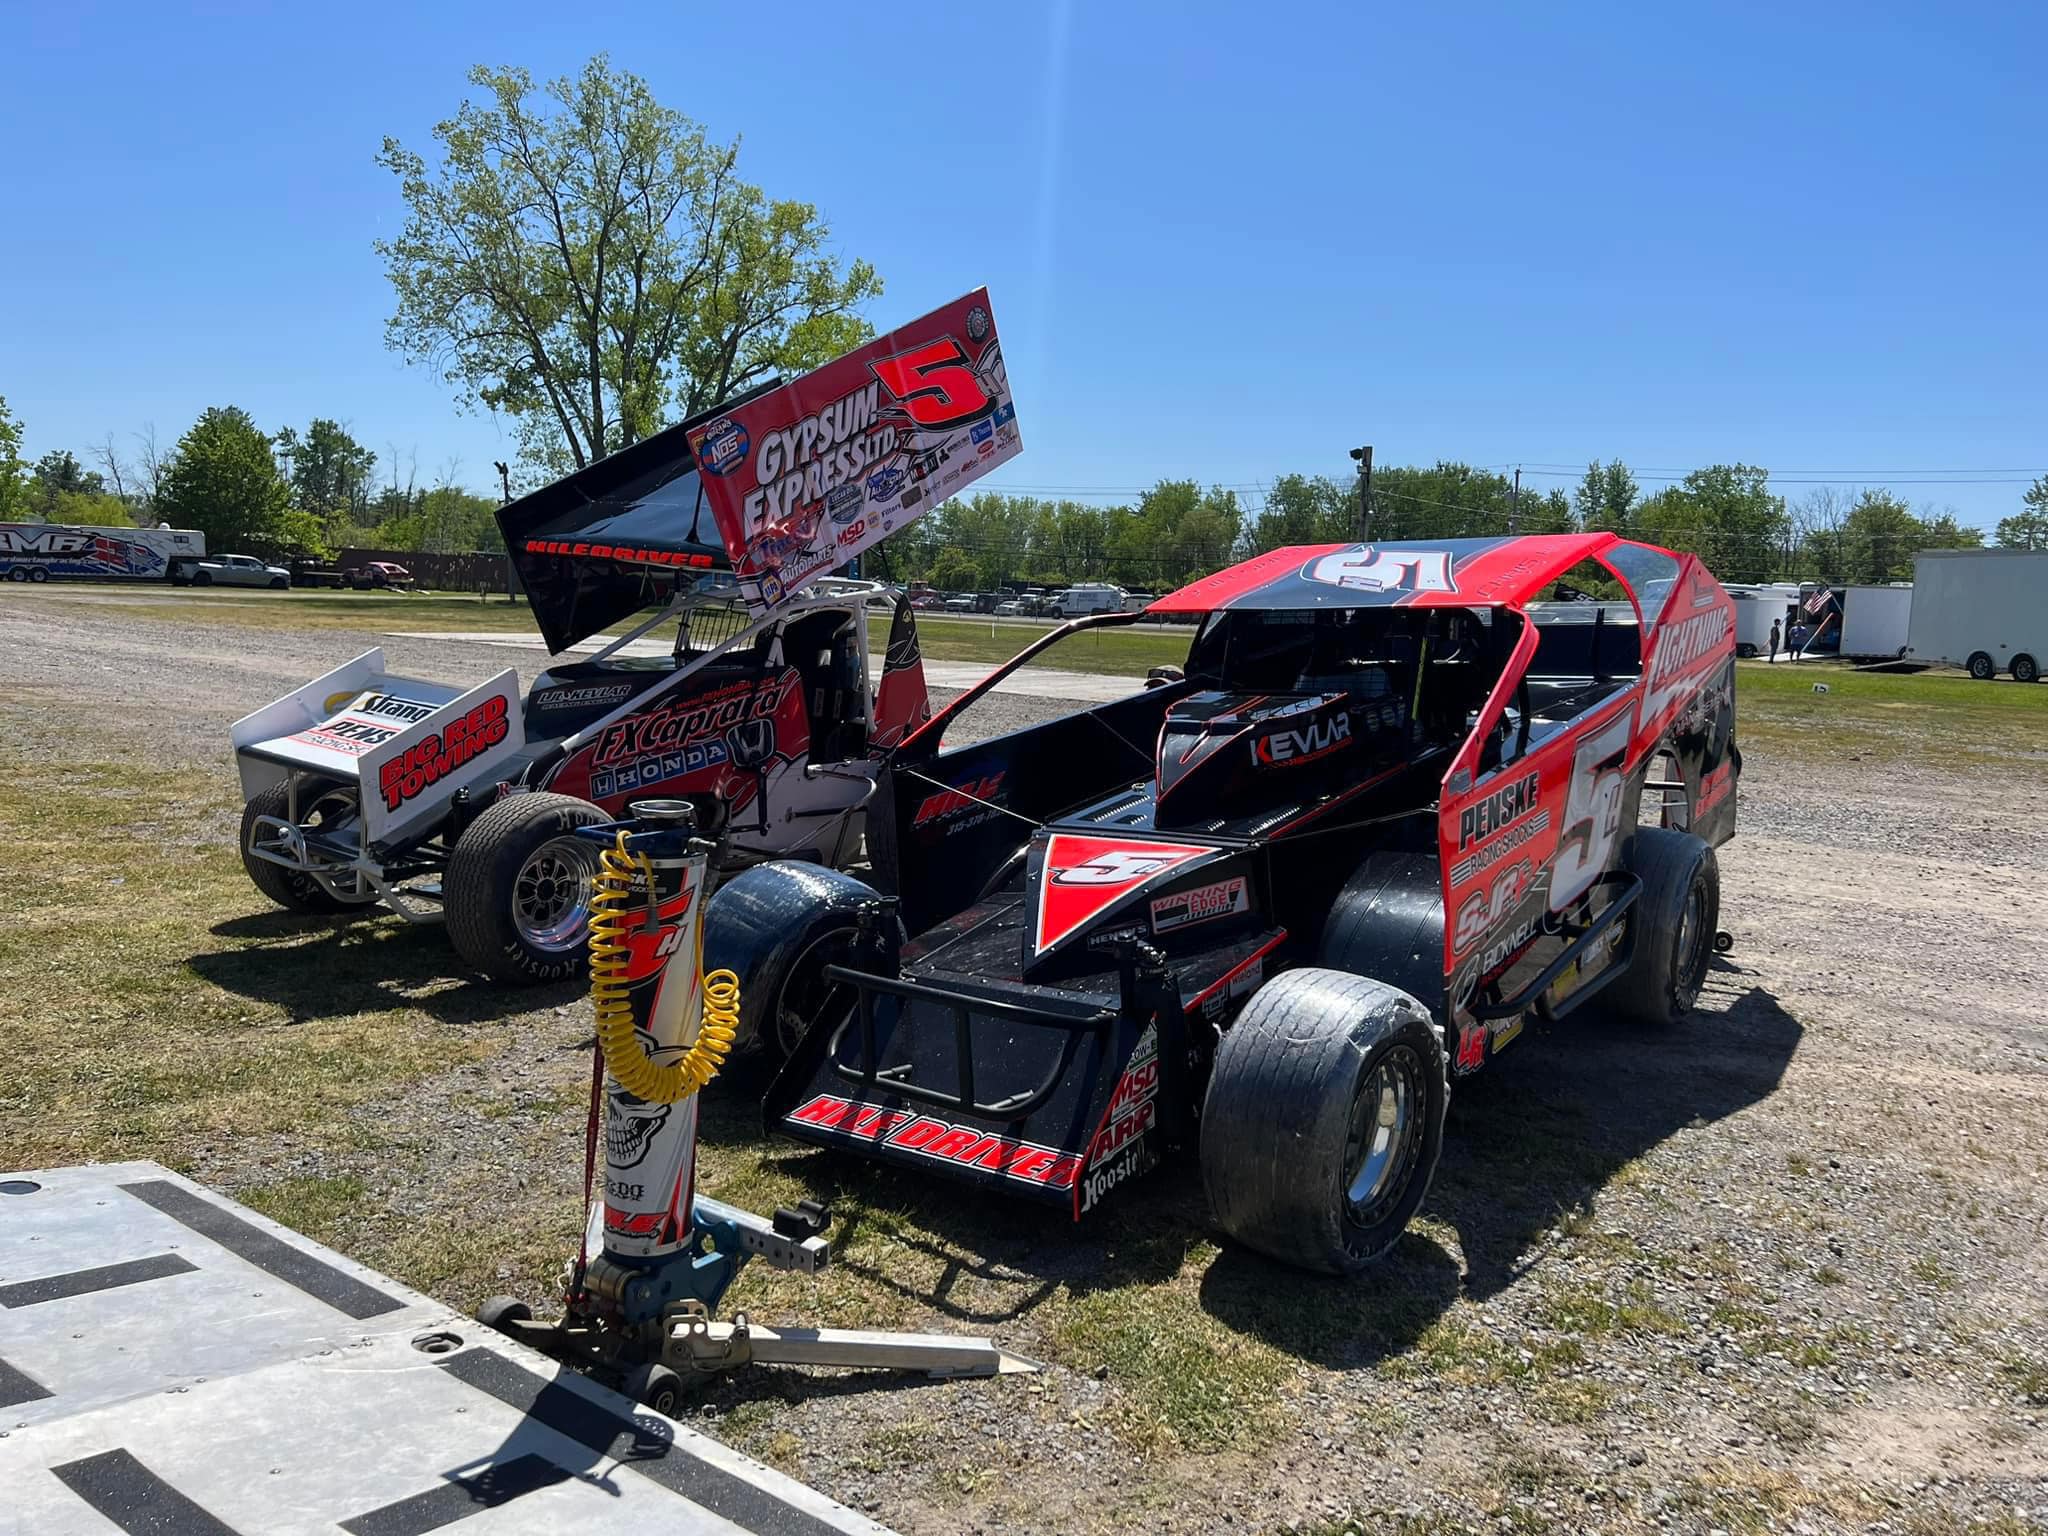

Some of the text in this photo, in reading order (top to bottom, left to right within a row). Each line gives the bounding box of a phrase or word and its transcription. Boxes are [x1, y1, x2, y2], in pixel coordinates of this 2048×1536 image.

[711, 429, 738, 464] NOS
[756, 380, 880, 487] GYPSUM
[743, 436, 867, 541] EXPRESS
[837, 520, 866, 547] MSD
[1650, 605, 1729, 697] LIGHTNING
[353, 694, 440, 724] Strang
[379, 734, 443, 790] BIG
[442, 694, 510, 750] RED
[381, 716, 510, 813] TOWING
[615, 743, 727, 787] HONDA
[1250, 711, 1352, 767] KEVLAR
[1458, 771, 1540, 853] PENSKE
[1470, 818, 1536, 875] RACING SHOCKS
[1152, 879, 1242, 911] WINNING
[1191, 893, 1228, 913] EDGE
[1117, 1059, 1160, 1108] MSD
[888, 1119, 1084, 1189] DRIVER
[1094, 1104, 1154, 1162] ARP
